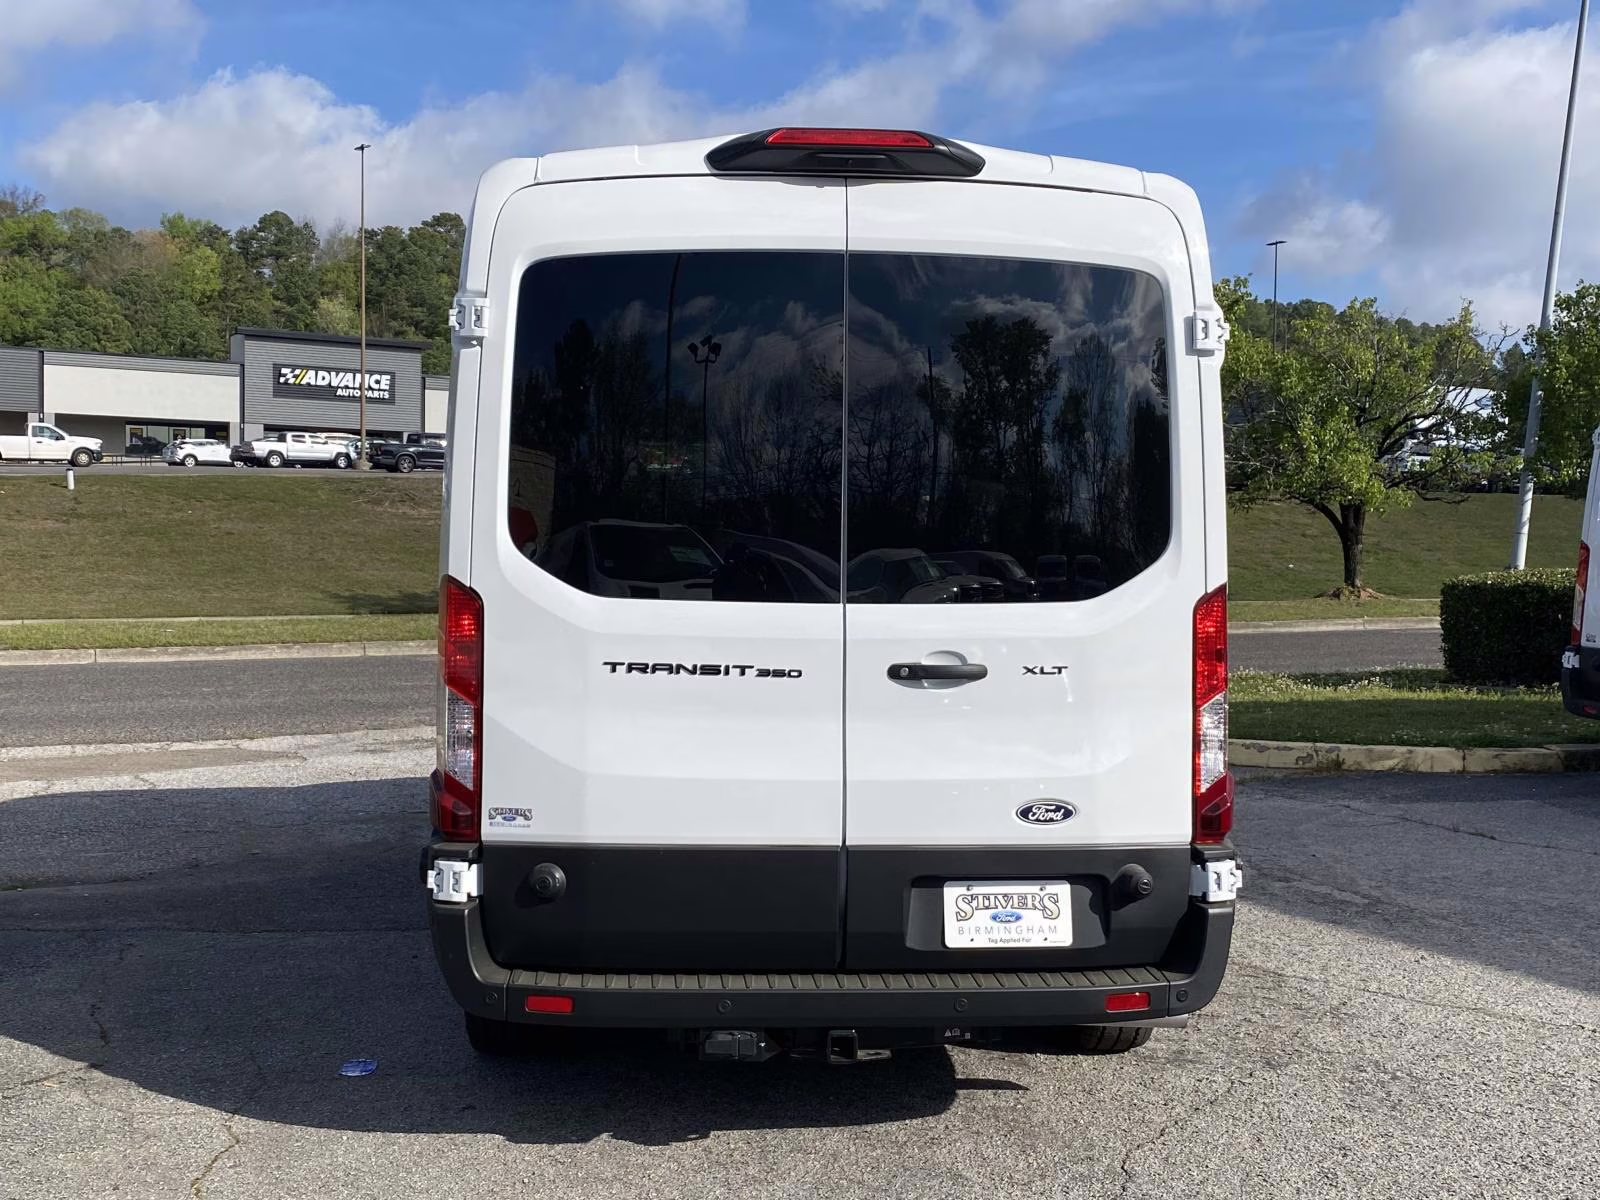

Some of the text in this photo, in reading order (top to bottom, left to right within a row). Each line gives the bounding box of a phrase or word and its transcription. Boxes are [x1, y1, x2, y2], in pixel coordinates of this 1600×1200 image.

[300, 369, 391, 390] ADVANCE
[336, 388, 361, 397] AUTO
[602, 661, 803, 679] TRANSIT 350
[1022, 665, 1068, 676] XLT
[1028, 804, 1065, 821] Ford
[955, 893, 1061, 922] STIVERS
[958, 925, 1057, 936] BIRMINGHAM
